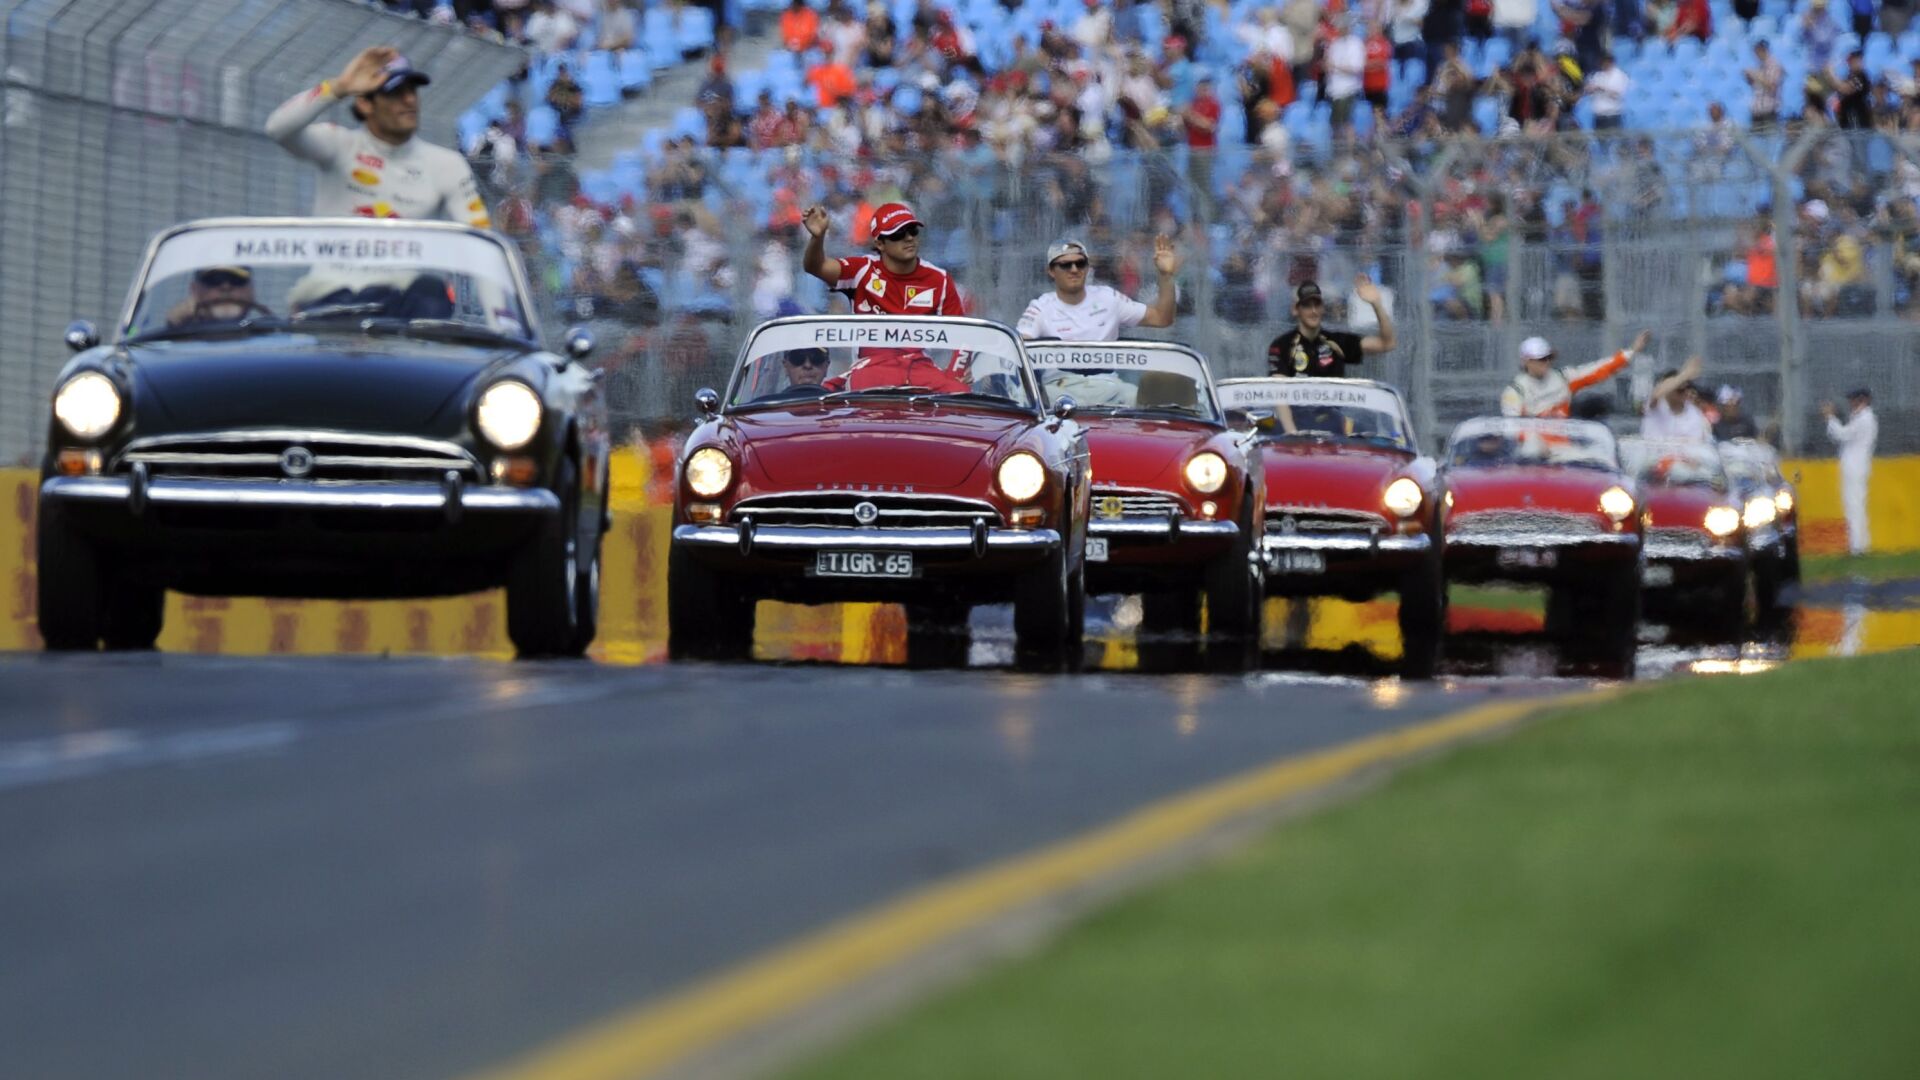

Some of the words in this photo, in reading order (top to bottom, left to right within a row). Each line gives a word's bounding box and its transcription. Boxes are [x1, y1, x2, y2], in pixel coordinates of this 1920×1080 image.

[235, 238, 307, 257] MARK
[815, 328, 879, 342] FELIPE
[884, 329, 949, 343] MASSA
[1071, 352, 1148, 366] ROSBERG
